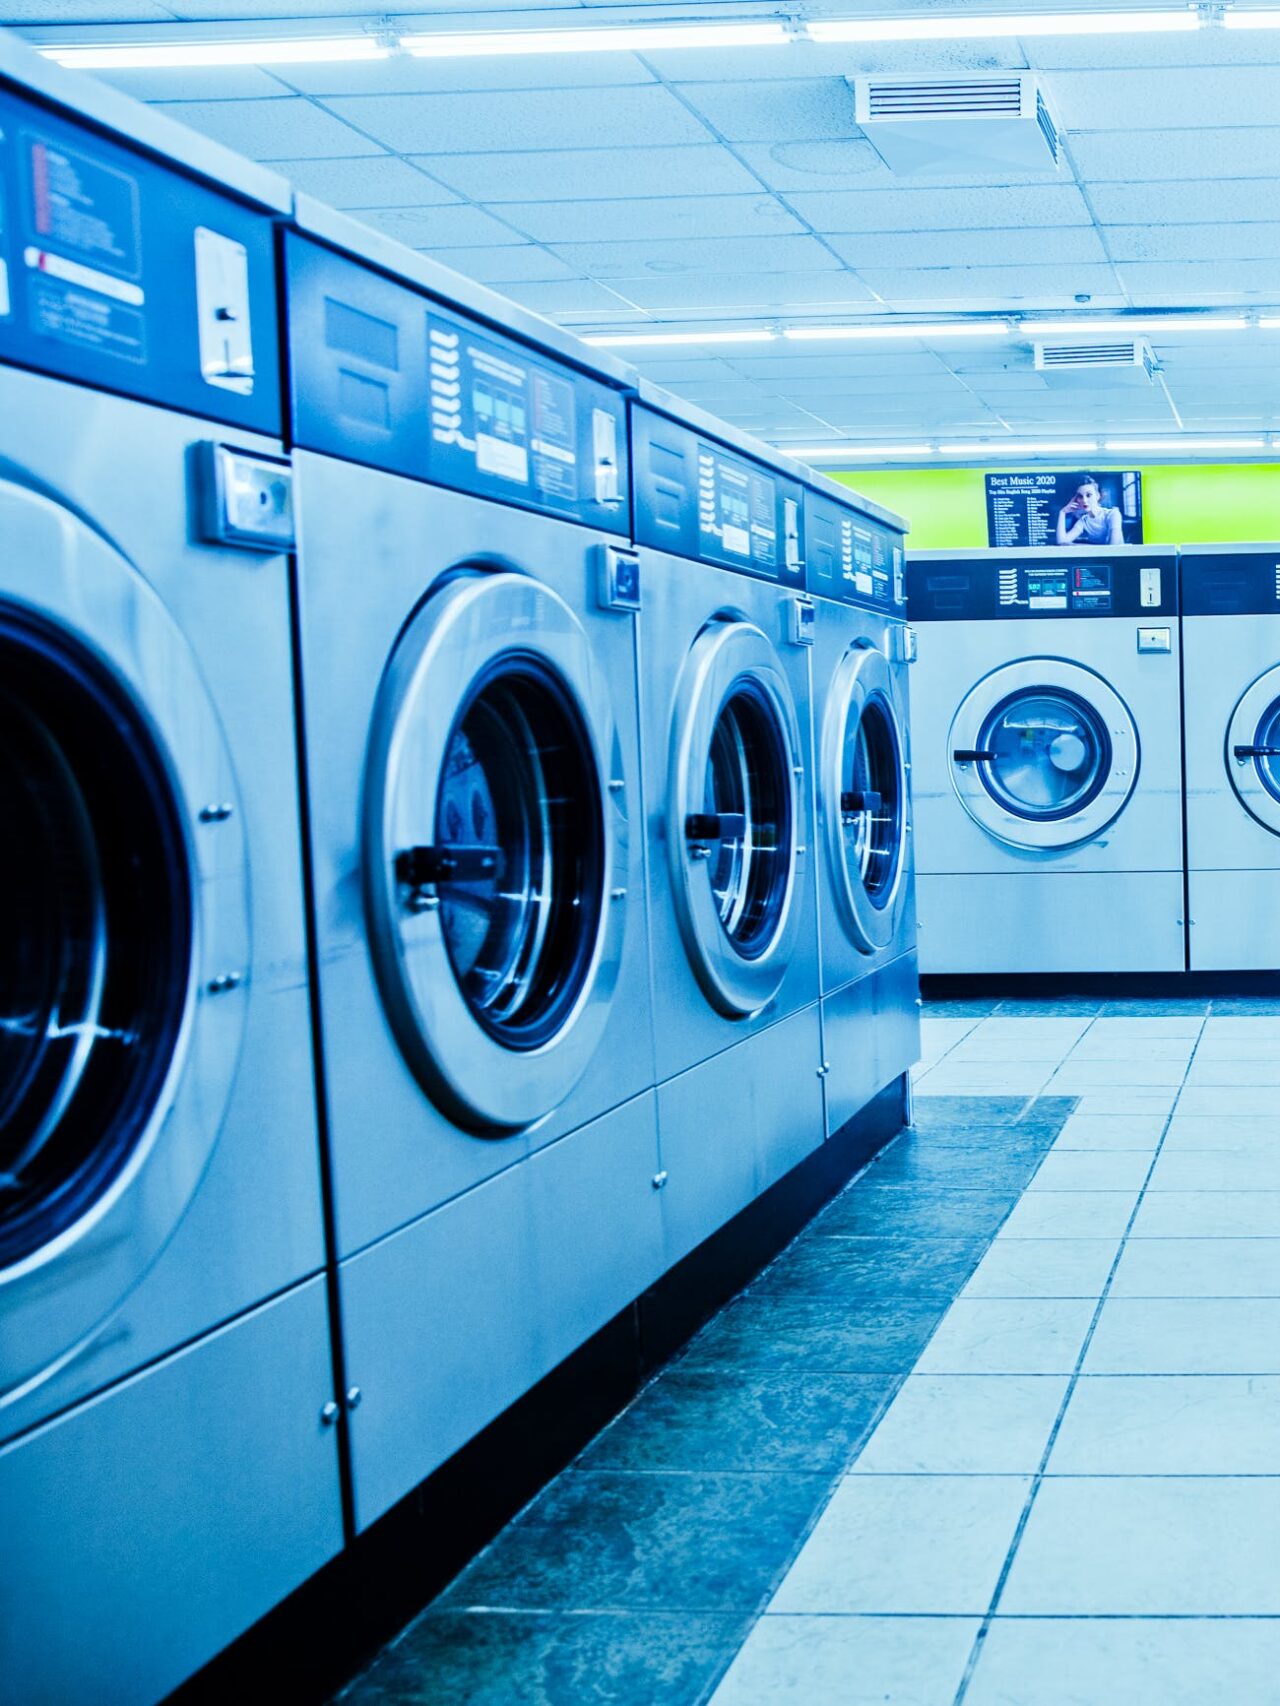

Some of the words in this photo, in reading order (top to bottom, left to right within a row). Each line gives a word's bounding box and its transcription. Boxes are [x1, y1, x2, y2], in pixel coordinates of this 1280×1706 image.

[990, 476, 1008, 486] Best
[1010, 476, 1034, 486] Music
[1036, 476, 1056, 485] 2020
